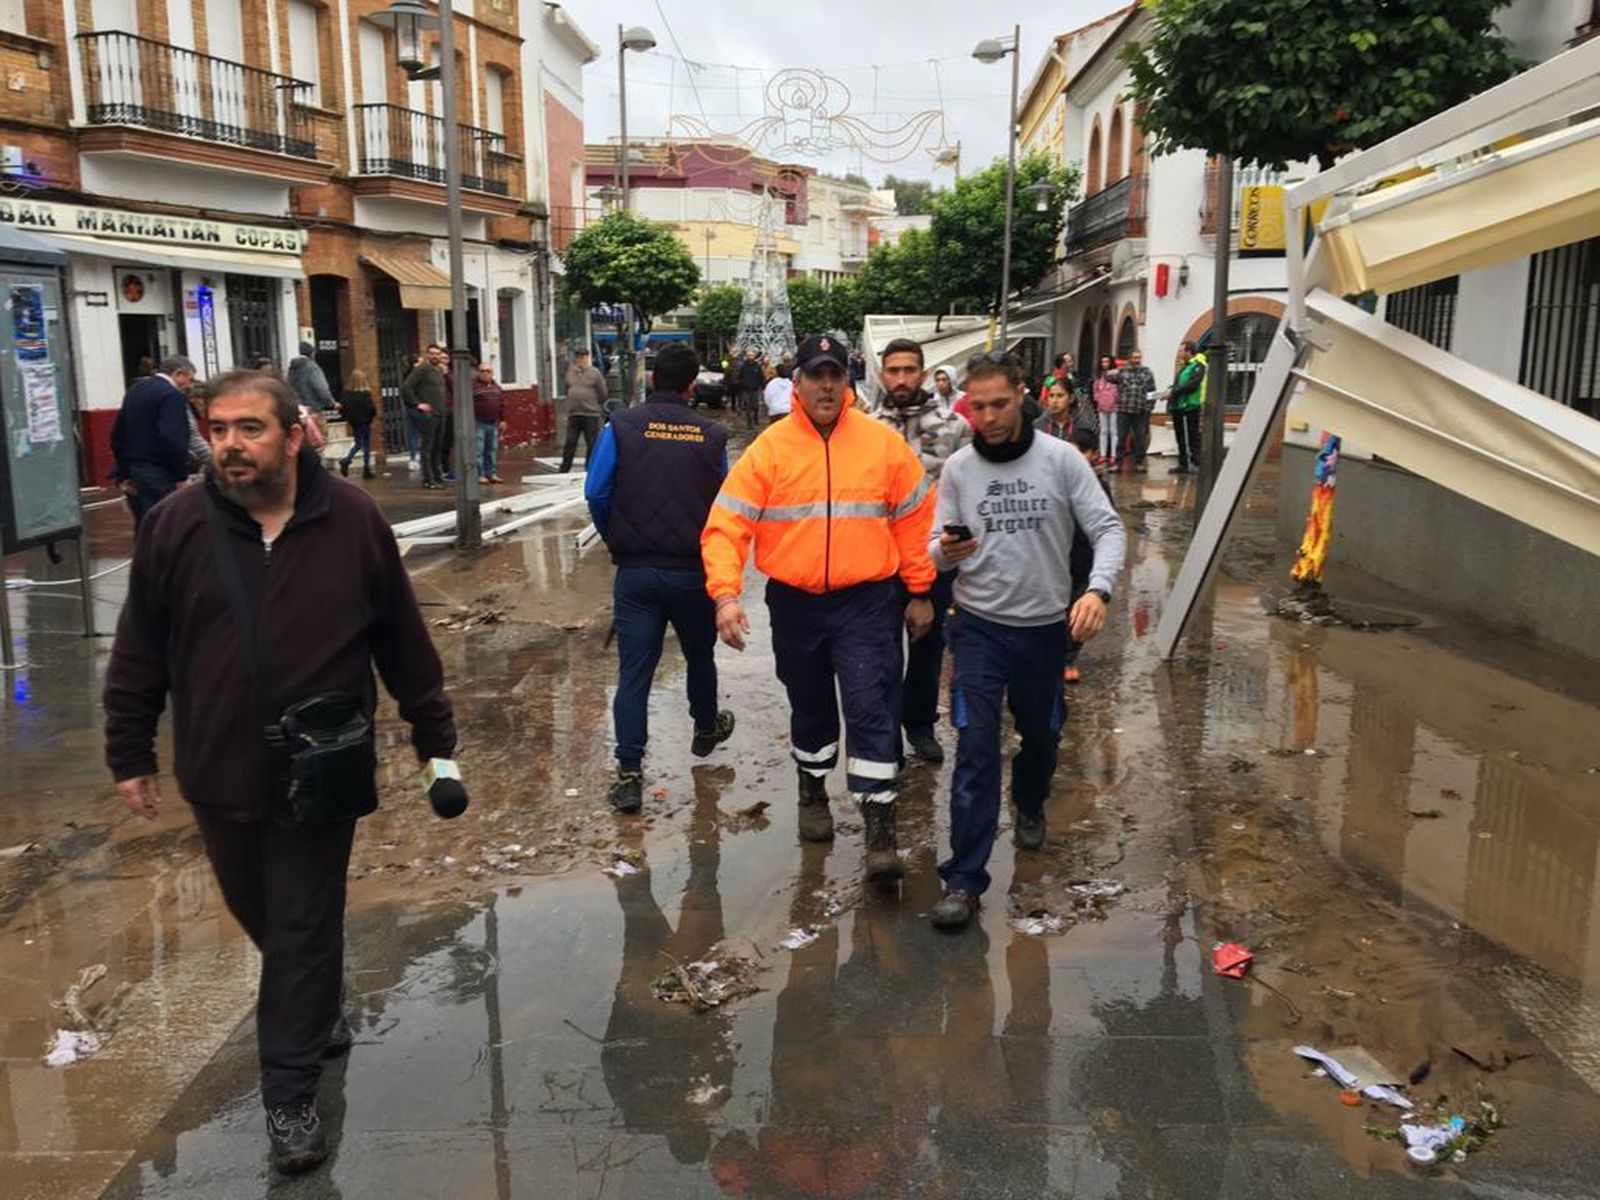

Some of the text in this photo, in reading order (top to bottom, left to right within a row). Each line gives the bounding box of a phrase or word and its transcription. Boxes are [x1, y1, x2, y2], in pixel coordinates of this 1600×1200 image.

[0, 201, 297, 250] BAR MANHATTAN COPAS
[648, 422, 701, 434] DOS SANTOS
[977, 498, 1048, 516] Culture
